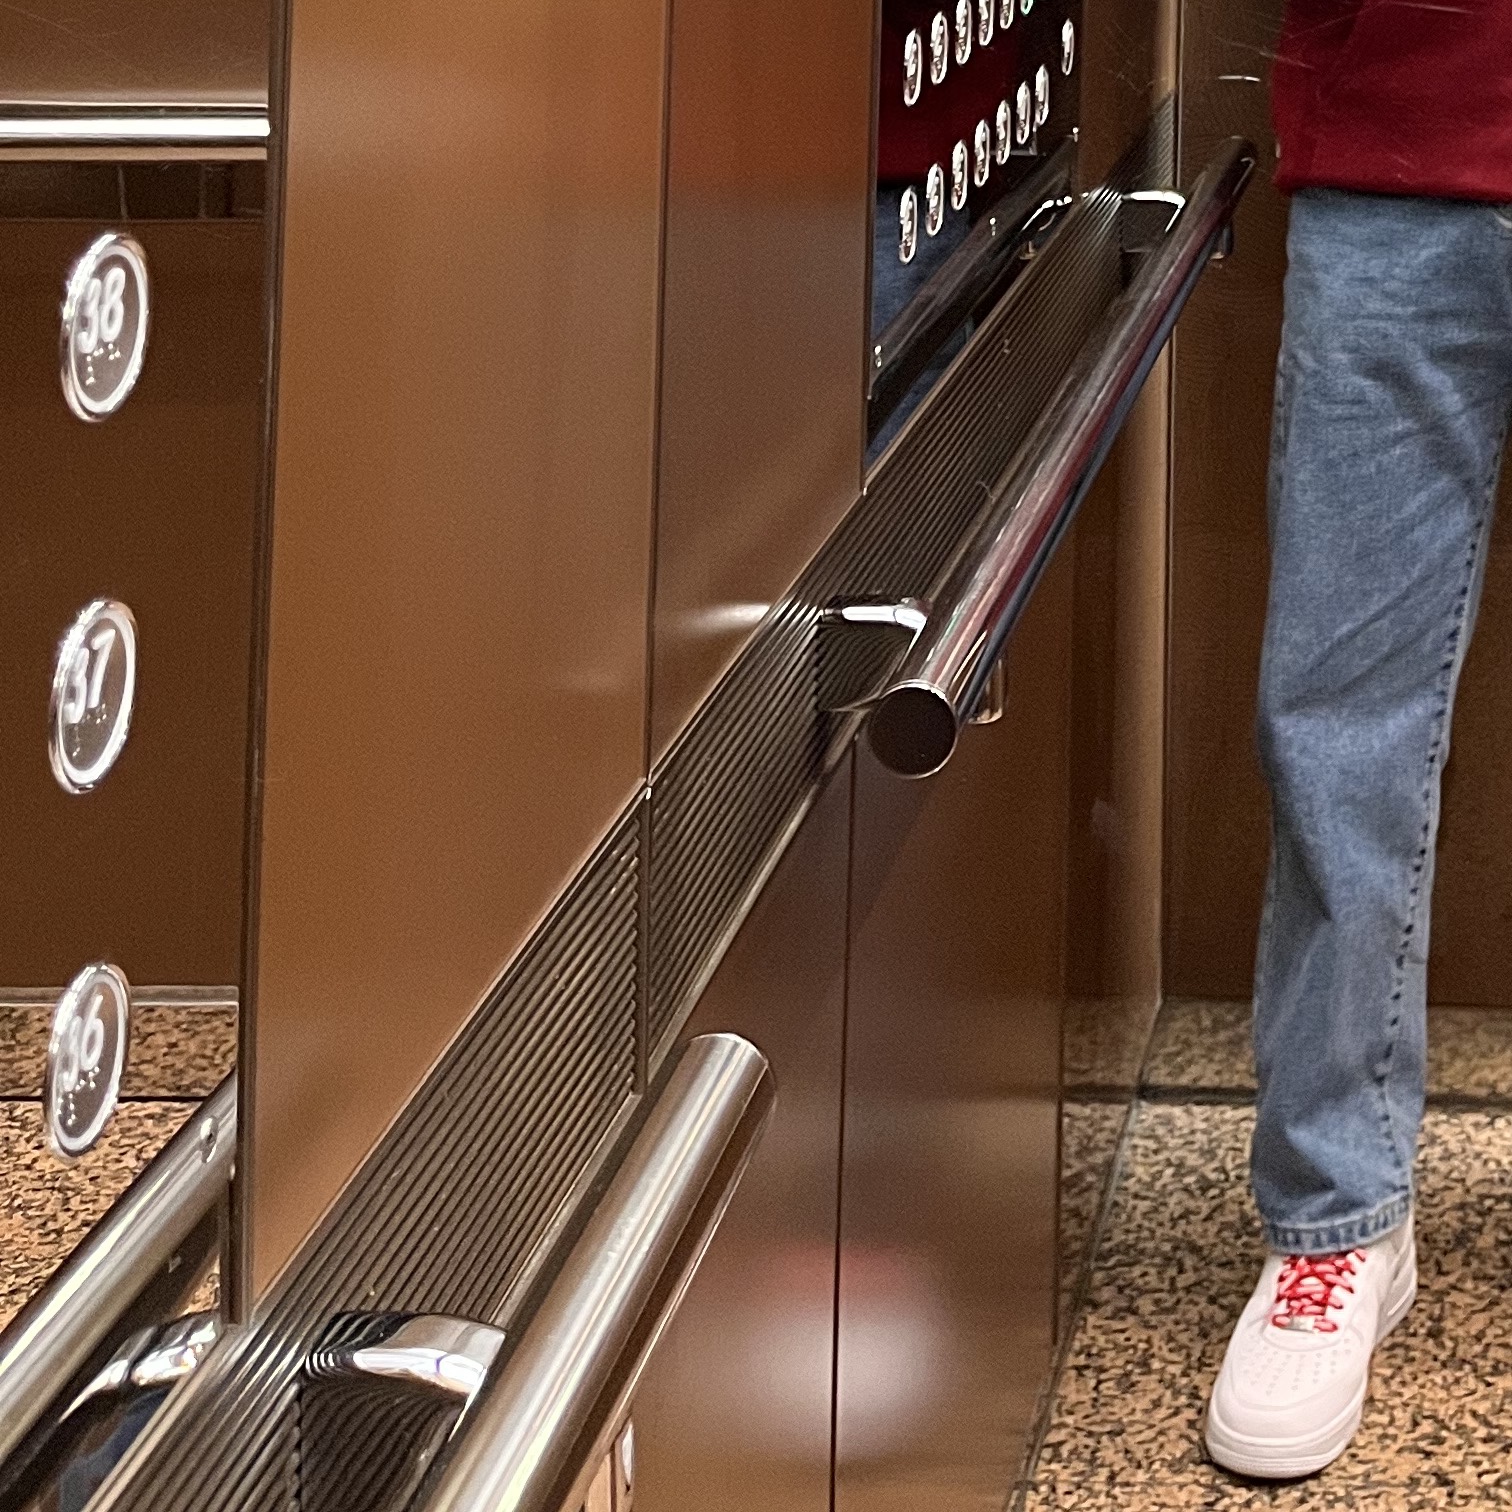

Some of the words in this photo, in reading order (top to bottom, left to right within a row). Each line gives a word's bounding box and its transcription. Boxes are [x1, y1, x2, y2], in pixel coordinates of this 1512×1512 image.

[77, 266, 126, 354] 38
[63, 628, 116, 724] 37
[59, 993, 105, 1092] 36
